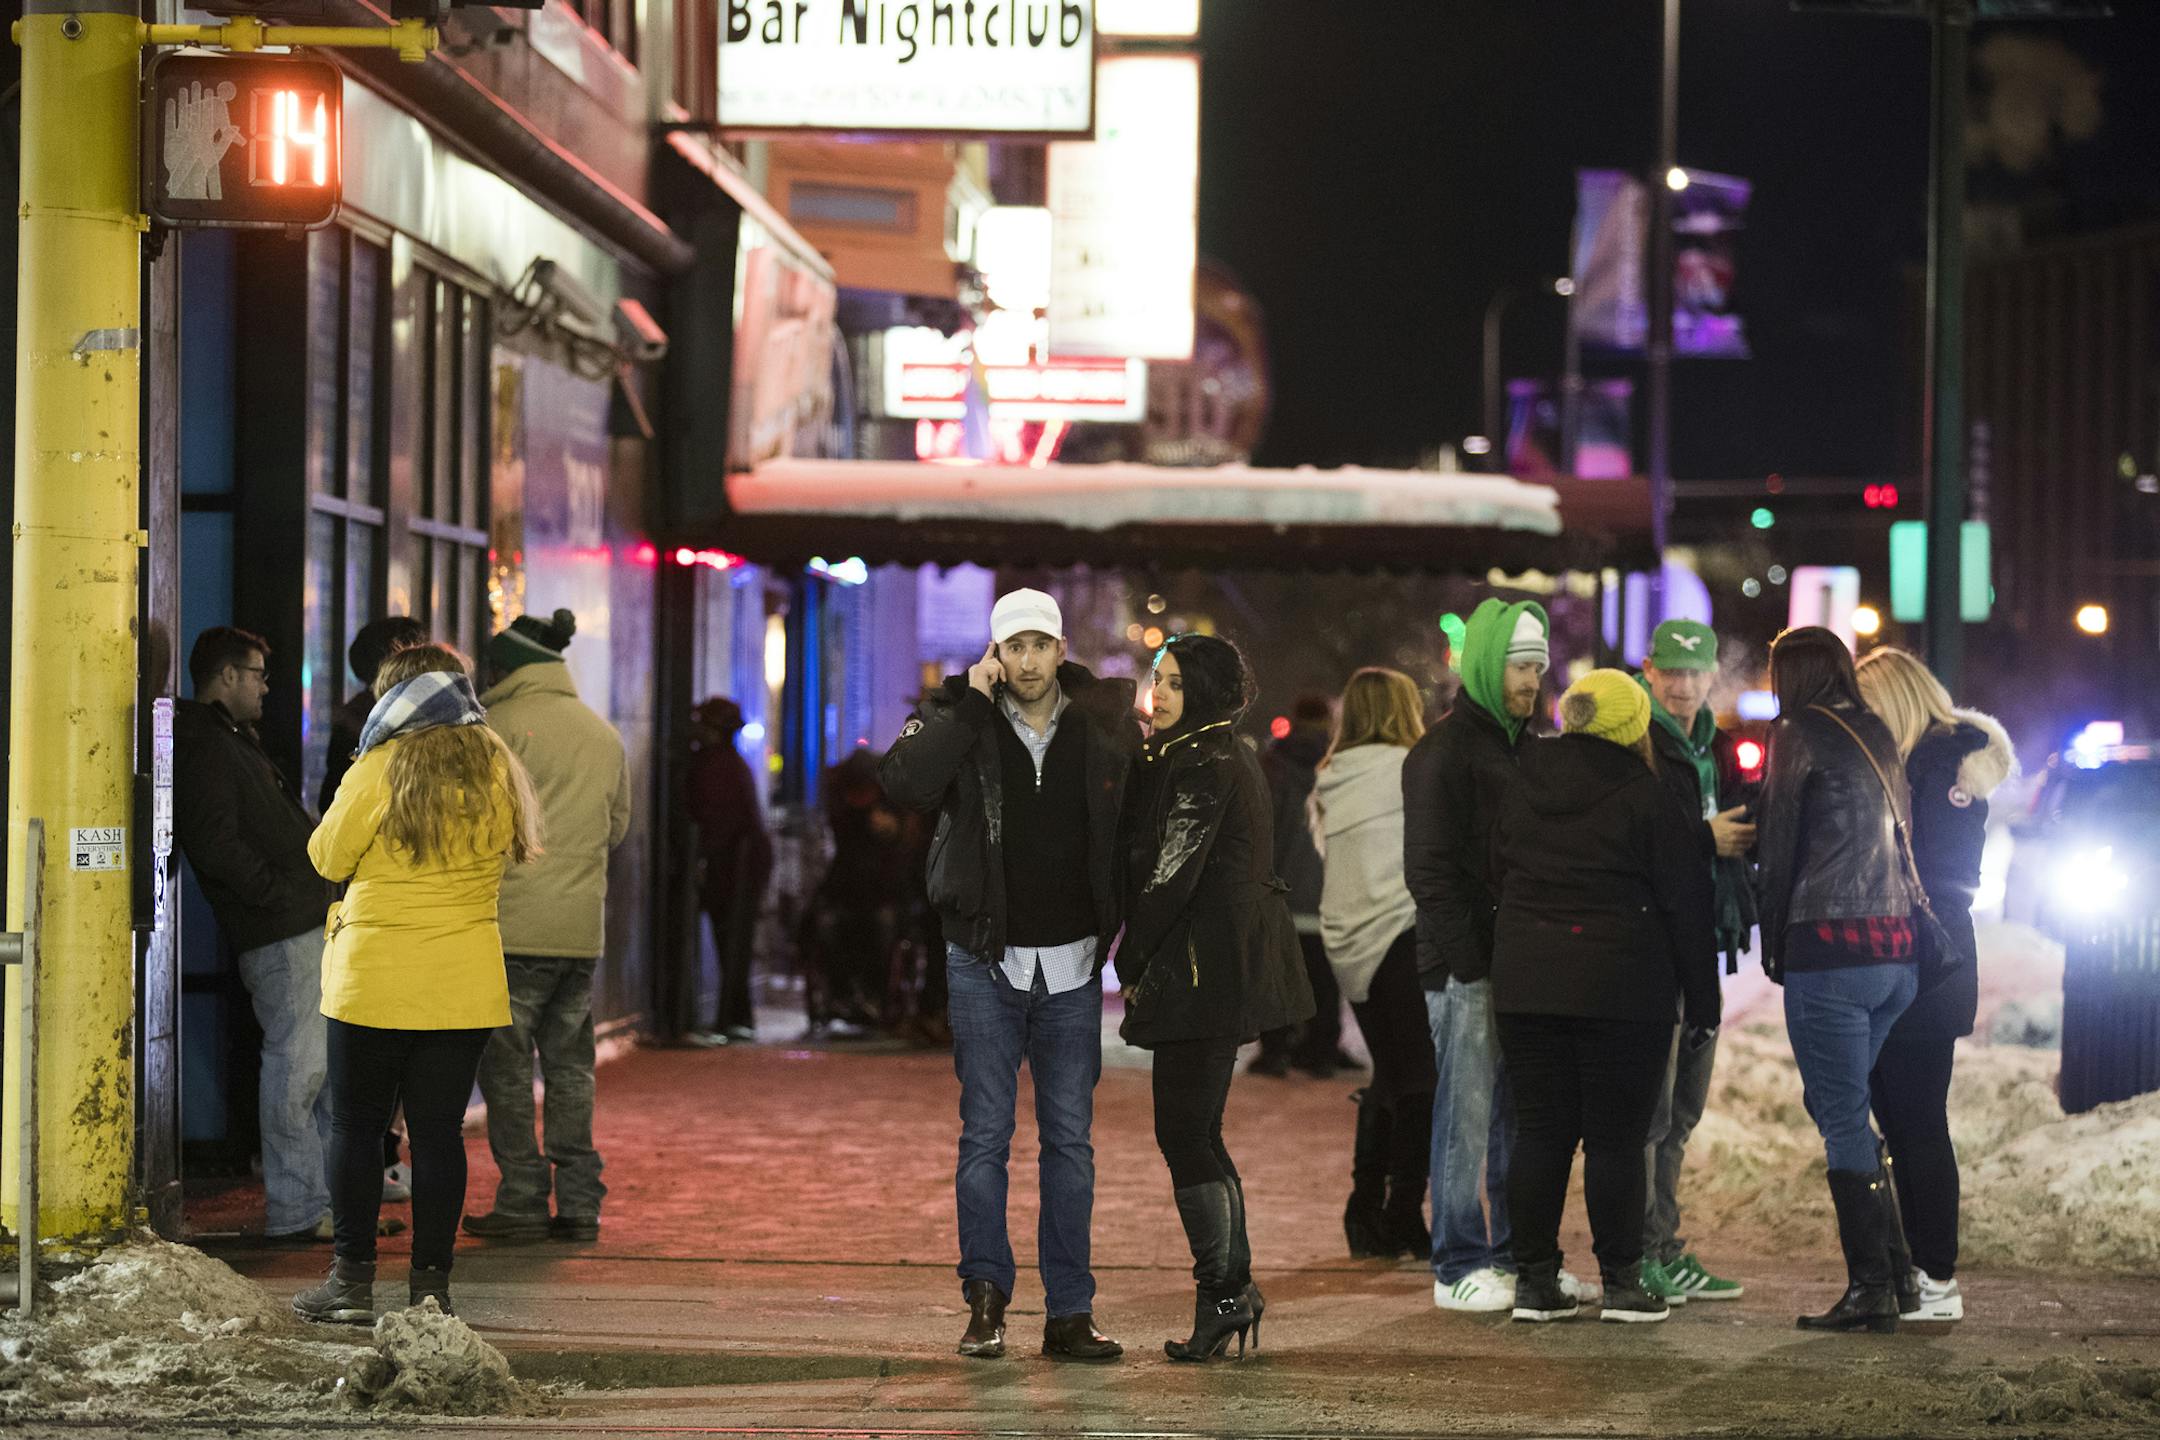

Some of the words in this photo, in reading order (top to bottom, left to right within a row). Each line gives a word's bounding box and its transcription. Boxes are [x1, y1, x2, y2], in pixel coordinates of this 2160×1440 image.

[728, 0, 808, 43] Bar
[839, 0, 1082, 63] Nightclub
[273, 90, 327, 187] 14
[77, 829, 121, 841] KASH
